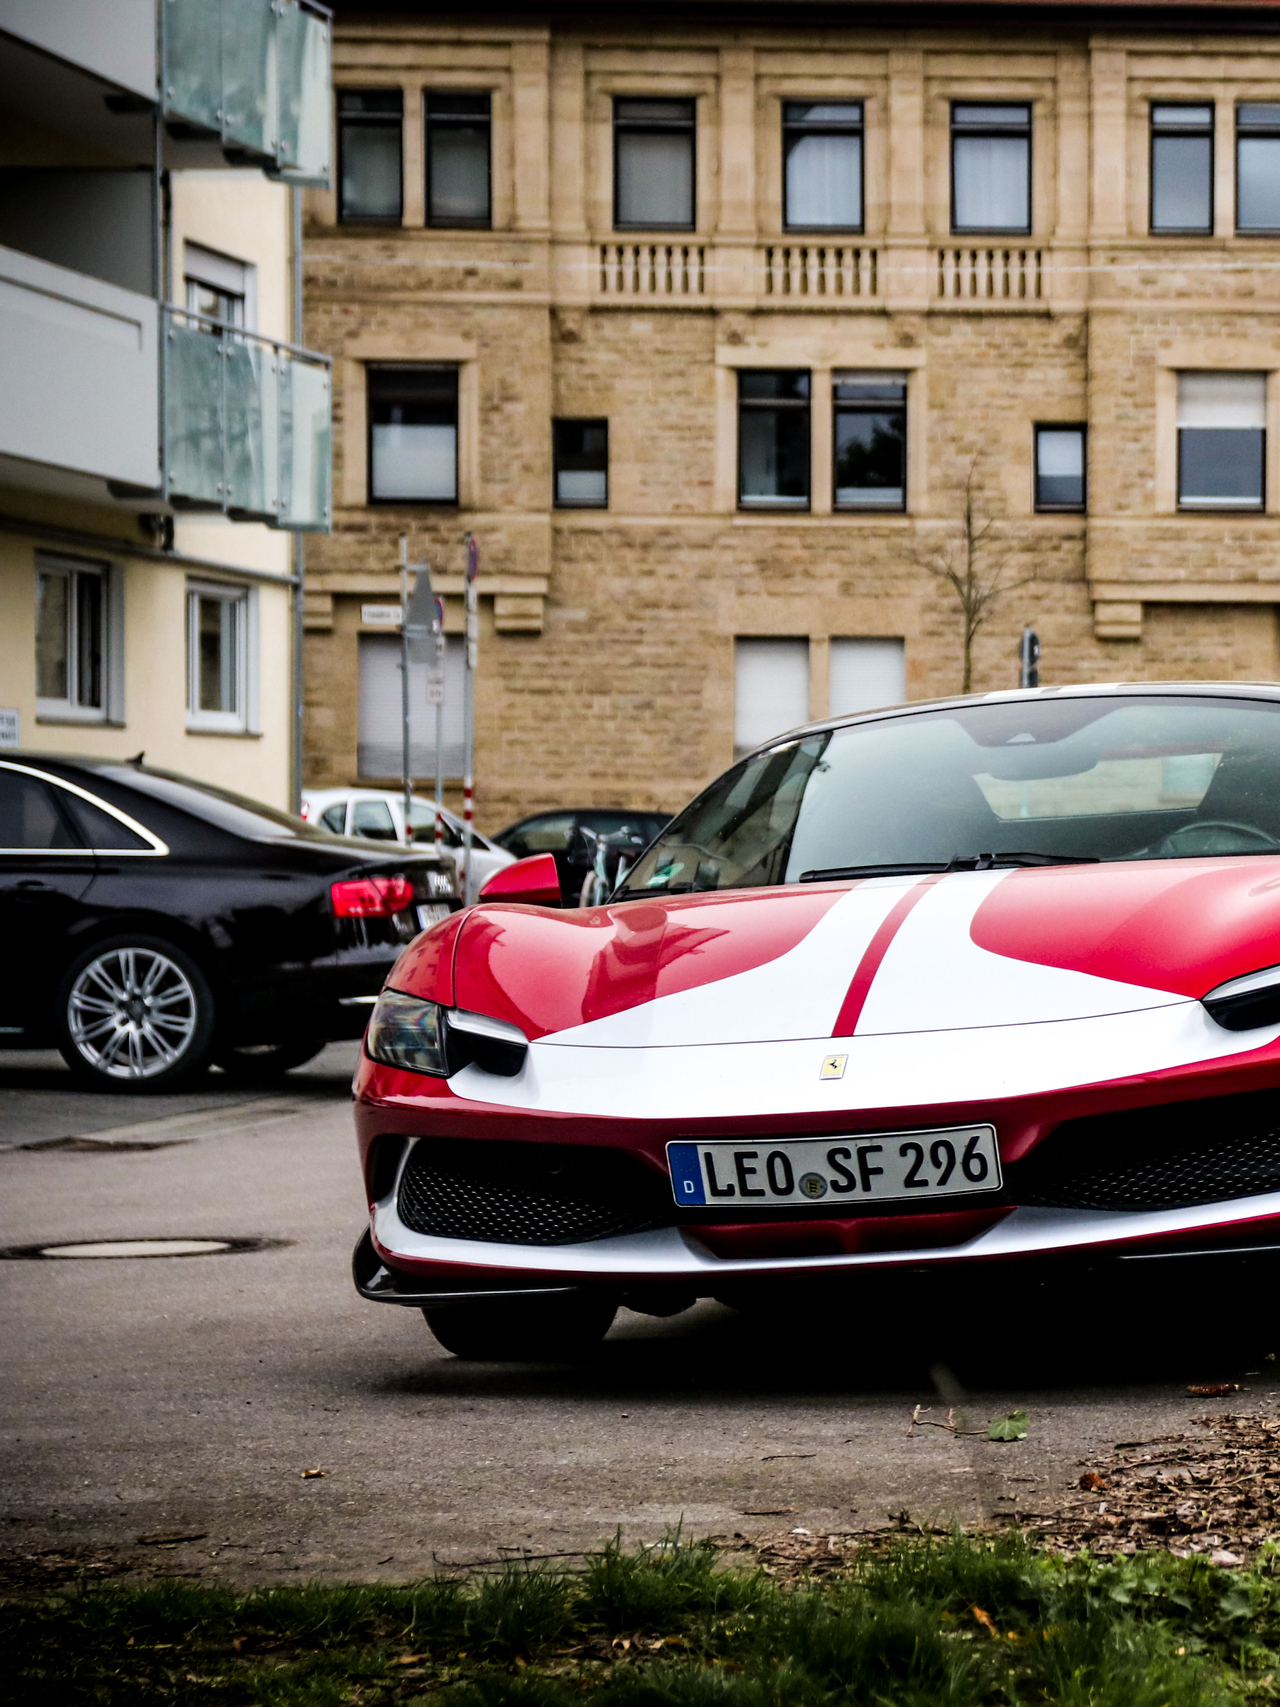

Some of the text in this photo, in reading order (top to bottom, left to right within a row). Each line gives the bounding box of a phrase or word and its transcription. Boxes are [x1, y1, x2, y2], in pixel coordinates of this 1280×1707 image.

[704, 1135, 989, 1198] LEO SF 296
[683, 1180, 695, 1194] D
